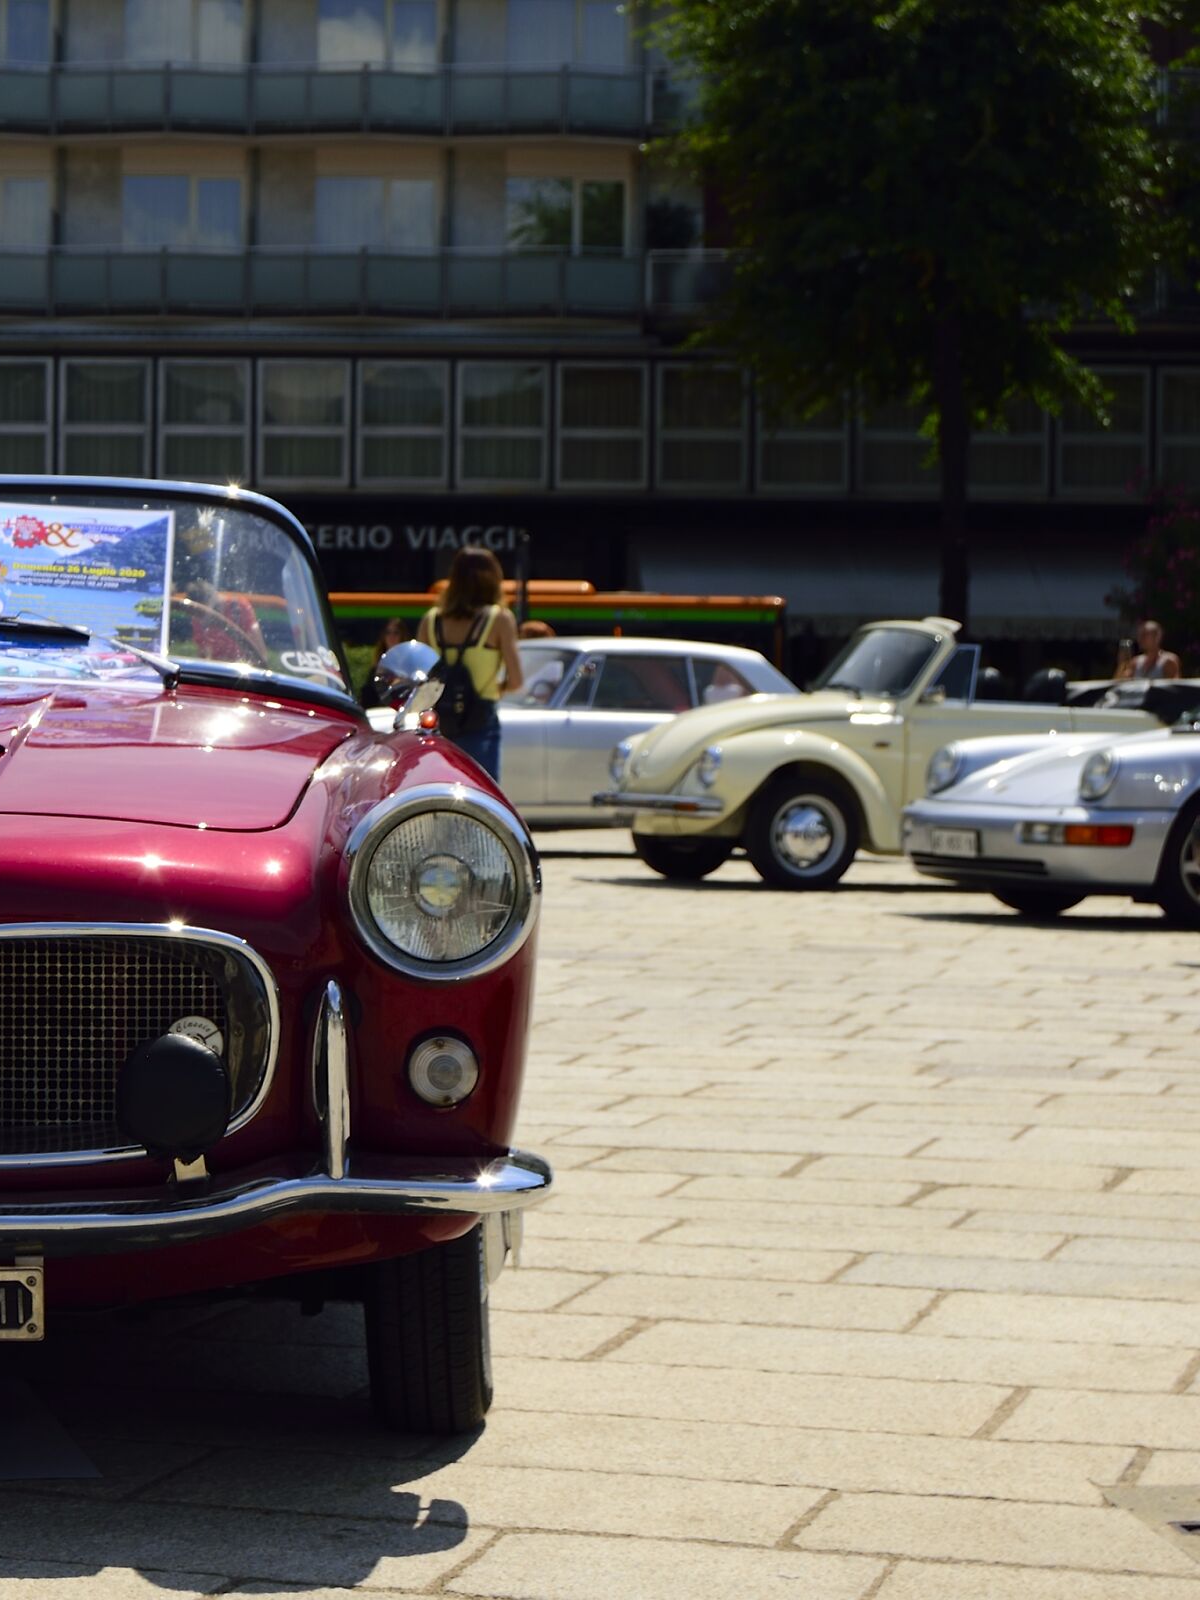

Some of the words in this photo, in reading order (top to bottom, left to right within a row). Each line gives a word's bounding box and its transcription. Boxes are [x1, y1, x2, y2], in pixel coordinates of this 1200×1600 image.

[406, 525, 516, 549] VIAGGI
[82, 566, 117, 576] Luglio
[119, 567, 146, 578] 2020
